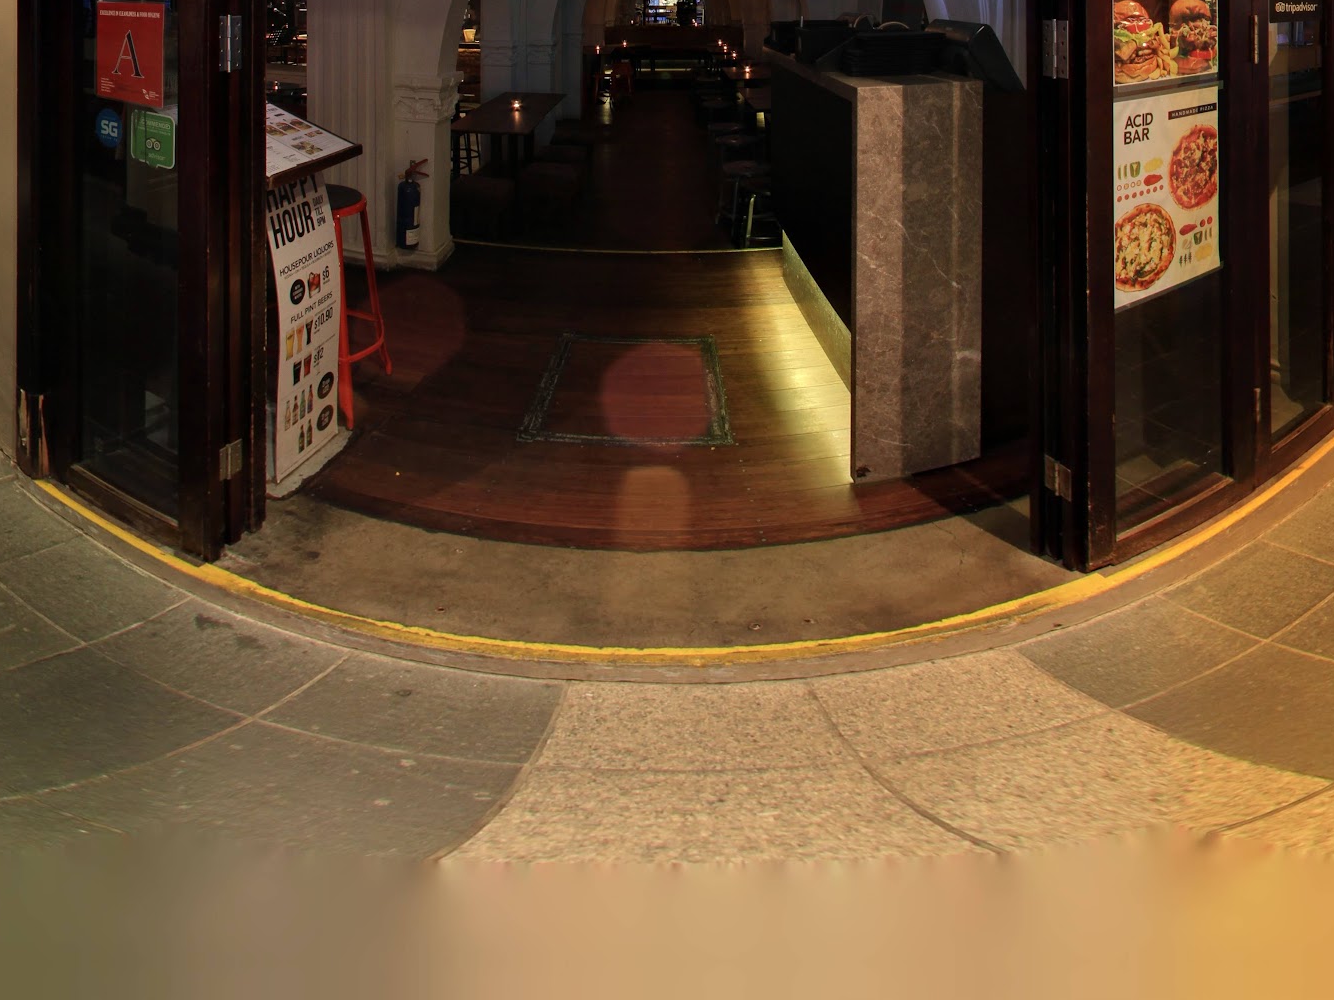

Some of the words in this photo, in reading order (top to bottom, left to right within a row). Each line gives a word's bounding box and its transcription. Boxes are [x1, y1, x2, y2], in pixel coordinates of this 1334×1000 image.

[1286, 1, 1315, 14] tripadvisor
[112, 29, 145, 79] A
[1171, 108, 1199, 118] HANDMADE
[1200, 104, 1214, 112] PIZZA
[100, 119, 118, 138] SG
[1124, 112, 1154, 130] ACID
[1123, 128, 1150, 145] BAR
[266, 172, 318, 213] HAPPY
[312, 194, 324, 207] DAILY
[314, 206, 323, 216] TILL
[270, 200, 316, 249] HOUR
[316, 215, 327, 227] 9PM
[279, 252, 313, 276] HOUSEPOUR
[313, 240, 334, 258] LIQUORS
[322, 265, 330, 281] $6
[290, 311, 304, 324] FULL
[305, 301, 317, 315] PINT
[317, 291, 333, 307] BEERS
[314, 306, 334, 330] $10.90
